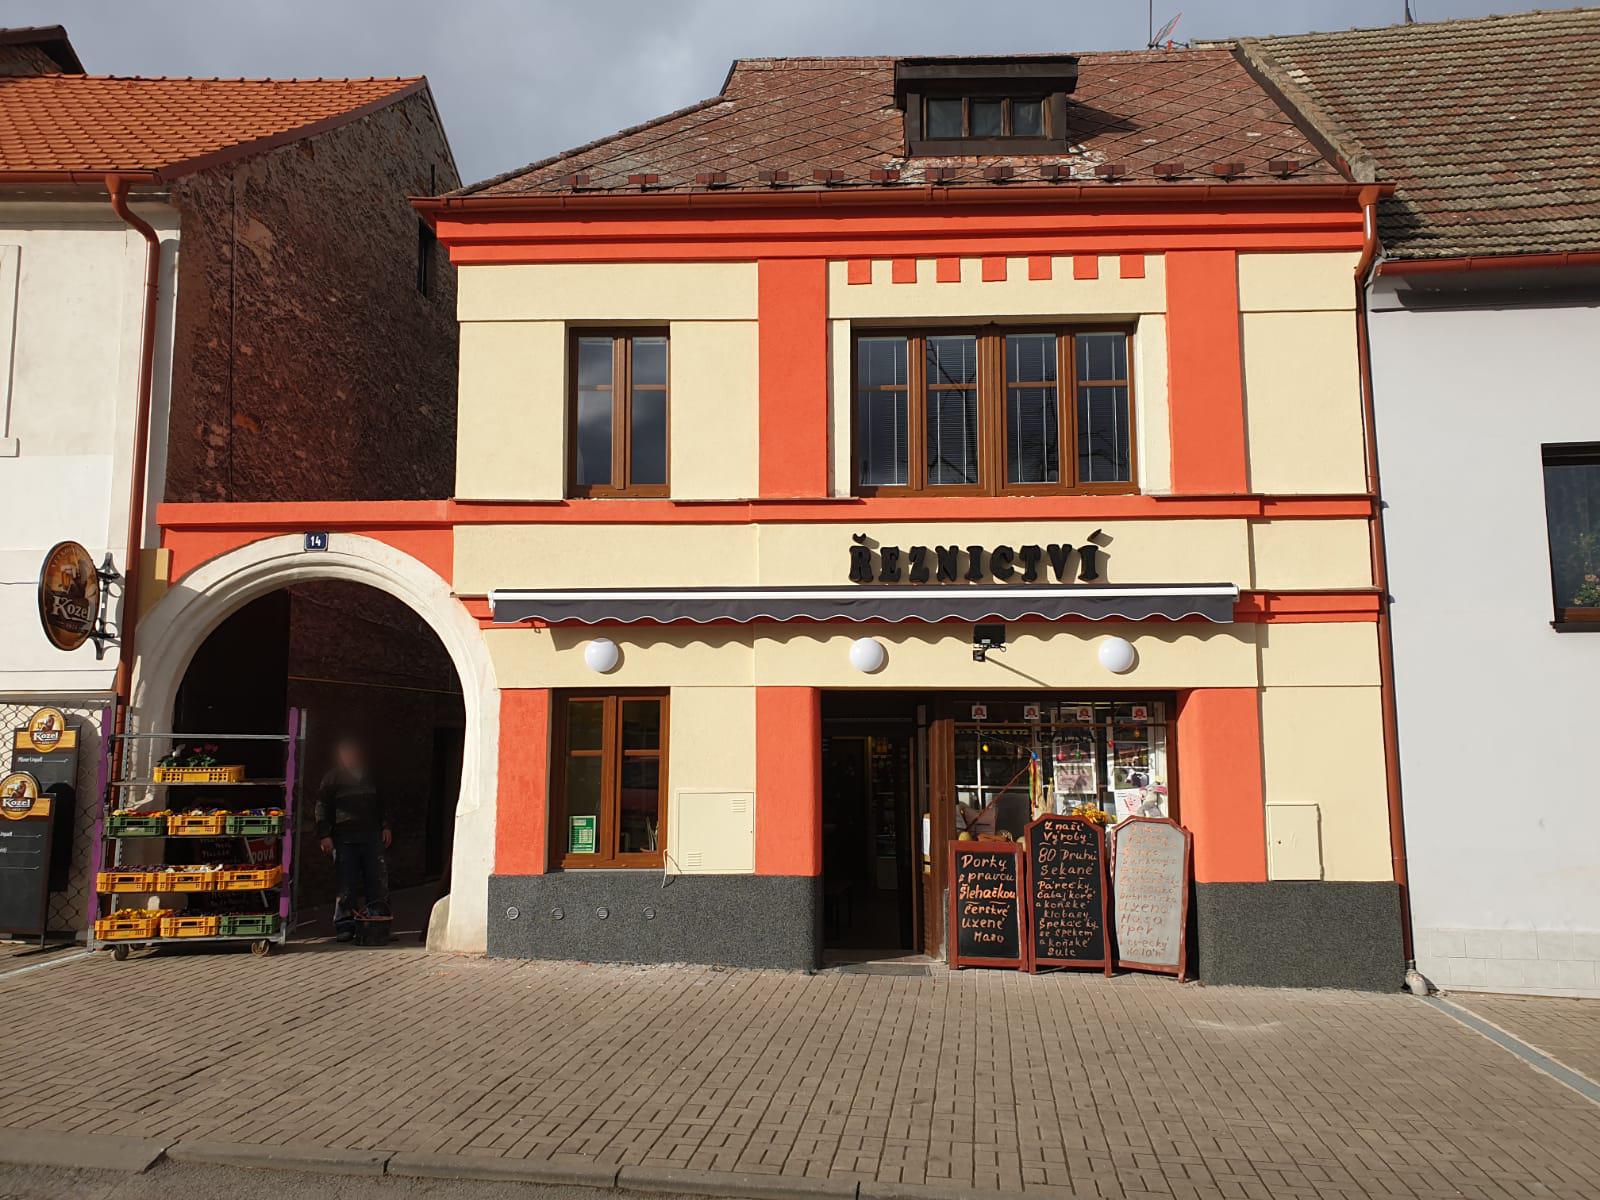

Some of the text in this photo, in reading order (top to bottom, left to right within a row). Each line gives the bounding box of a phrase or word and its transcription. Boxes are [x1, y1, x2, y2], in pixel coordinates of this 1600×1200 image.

[310, 535, 322, 547] 14
[848, 529, 1103, 583] ŘEZNICTVÍ
[51, 595, 91, 622] Kozel
[33, 731, 59, 742] Kozel
[2, 798, 31, 808] Kozel
[1038, 847, 1057, 863] 80
